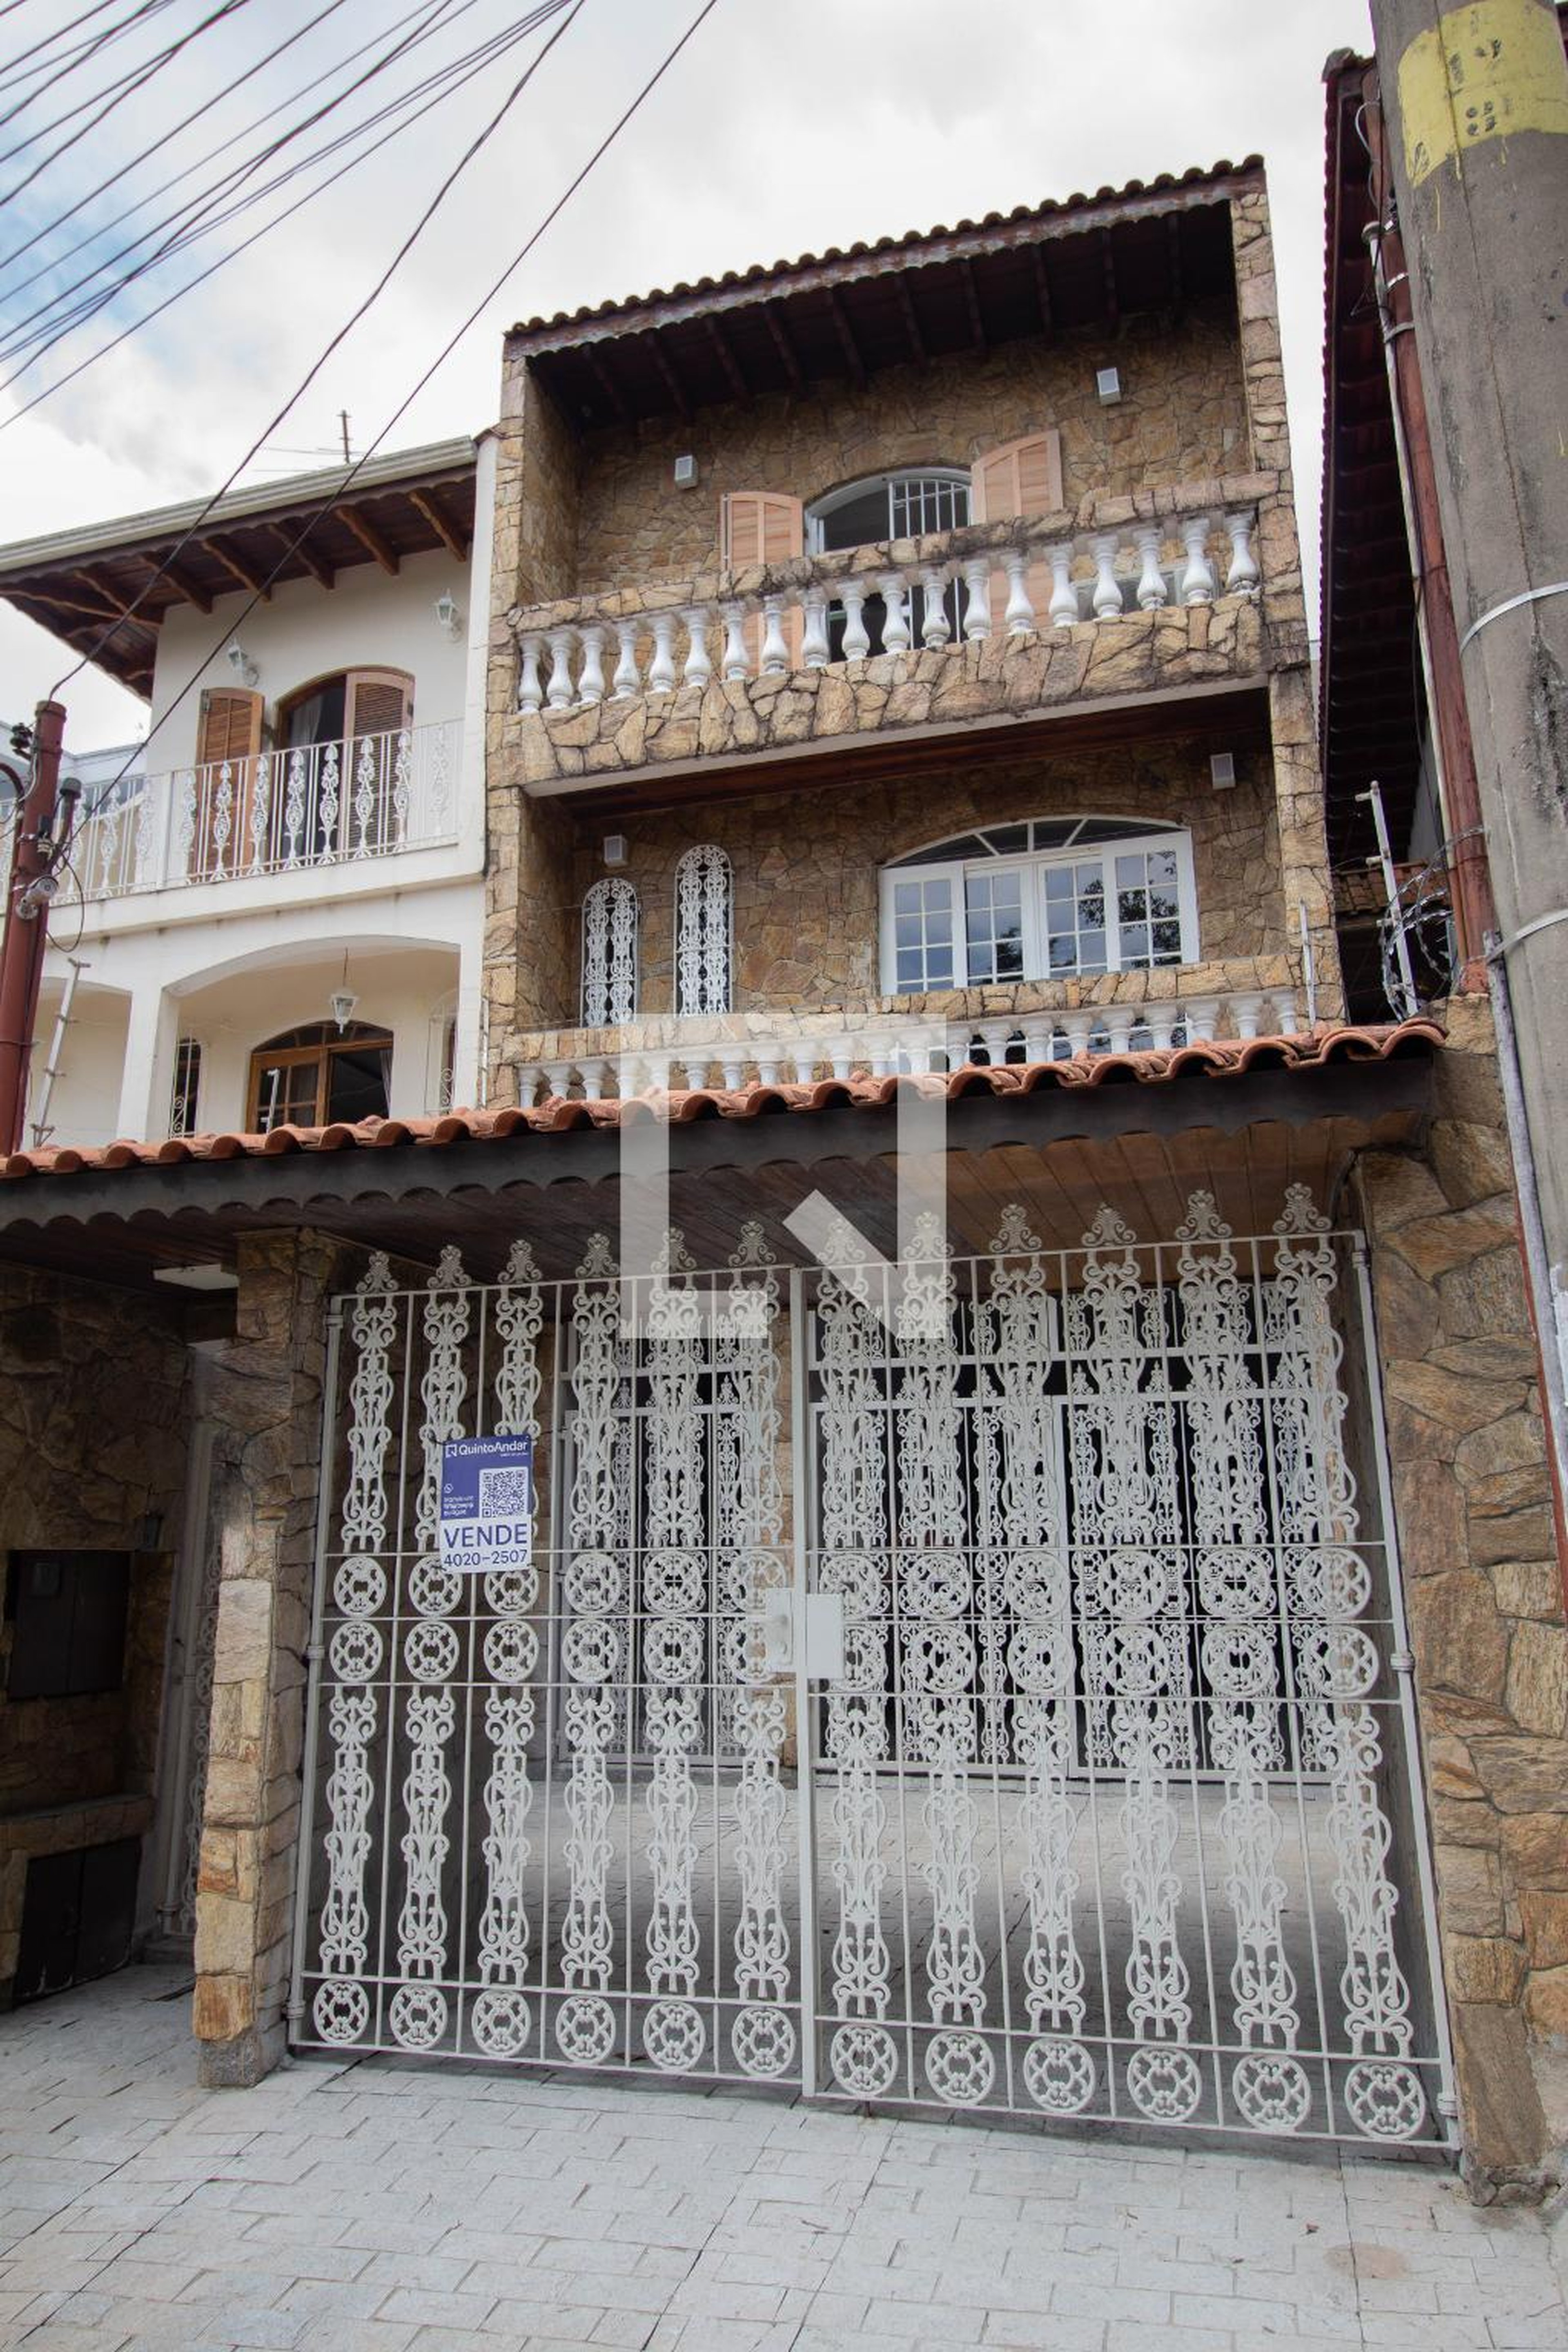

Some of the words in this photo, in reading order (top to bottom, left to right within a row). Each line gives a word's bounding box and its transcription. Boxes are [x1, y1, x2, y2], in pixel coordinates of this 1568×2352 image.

[459, 1440, 528, 1455] QuintoAndar
[443, 1523, 527, 1548] VENDE
[443, 1549, 527, 1567] 4020-2507
